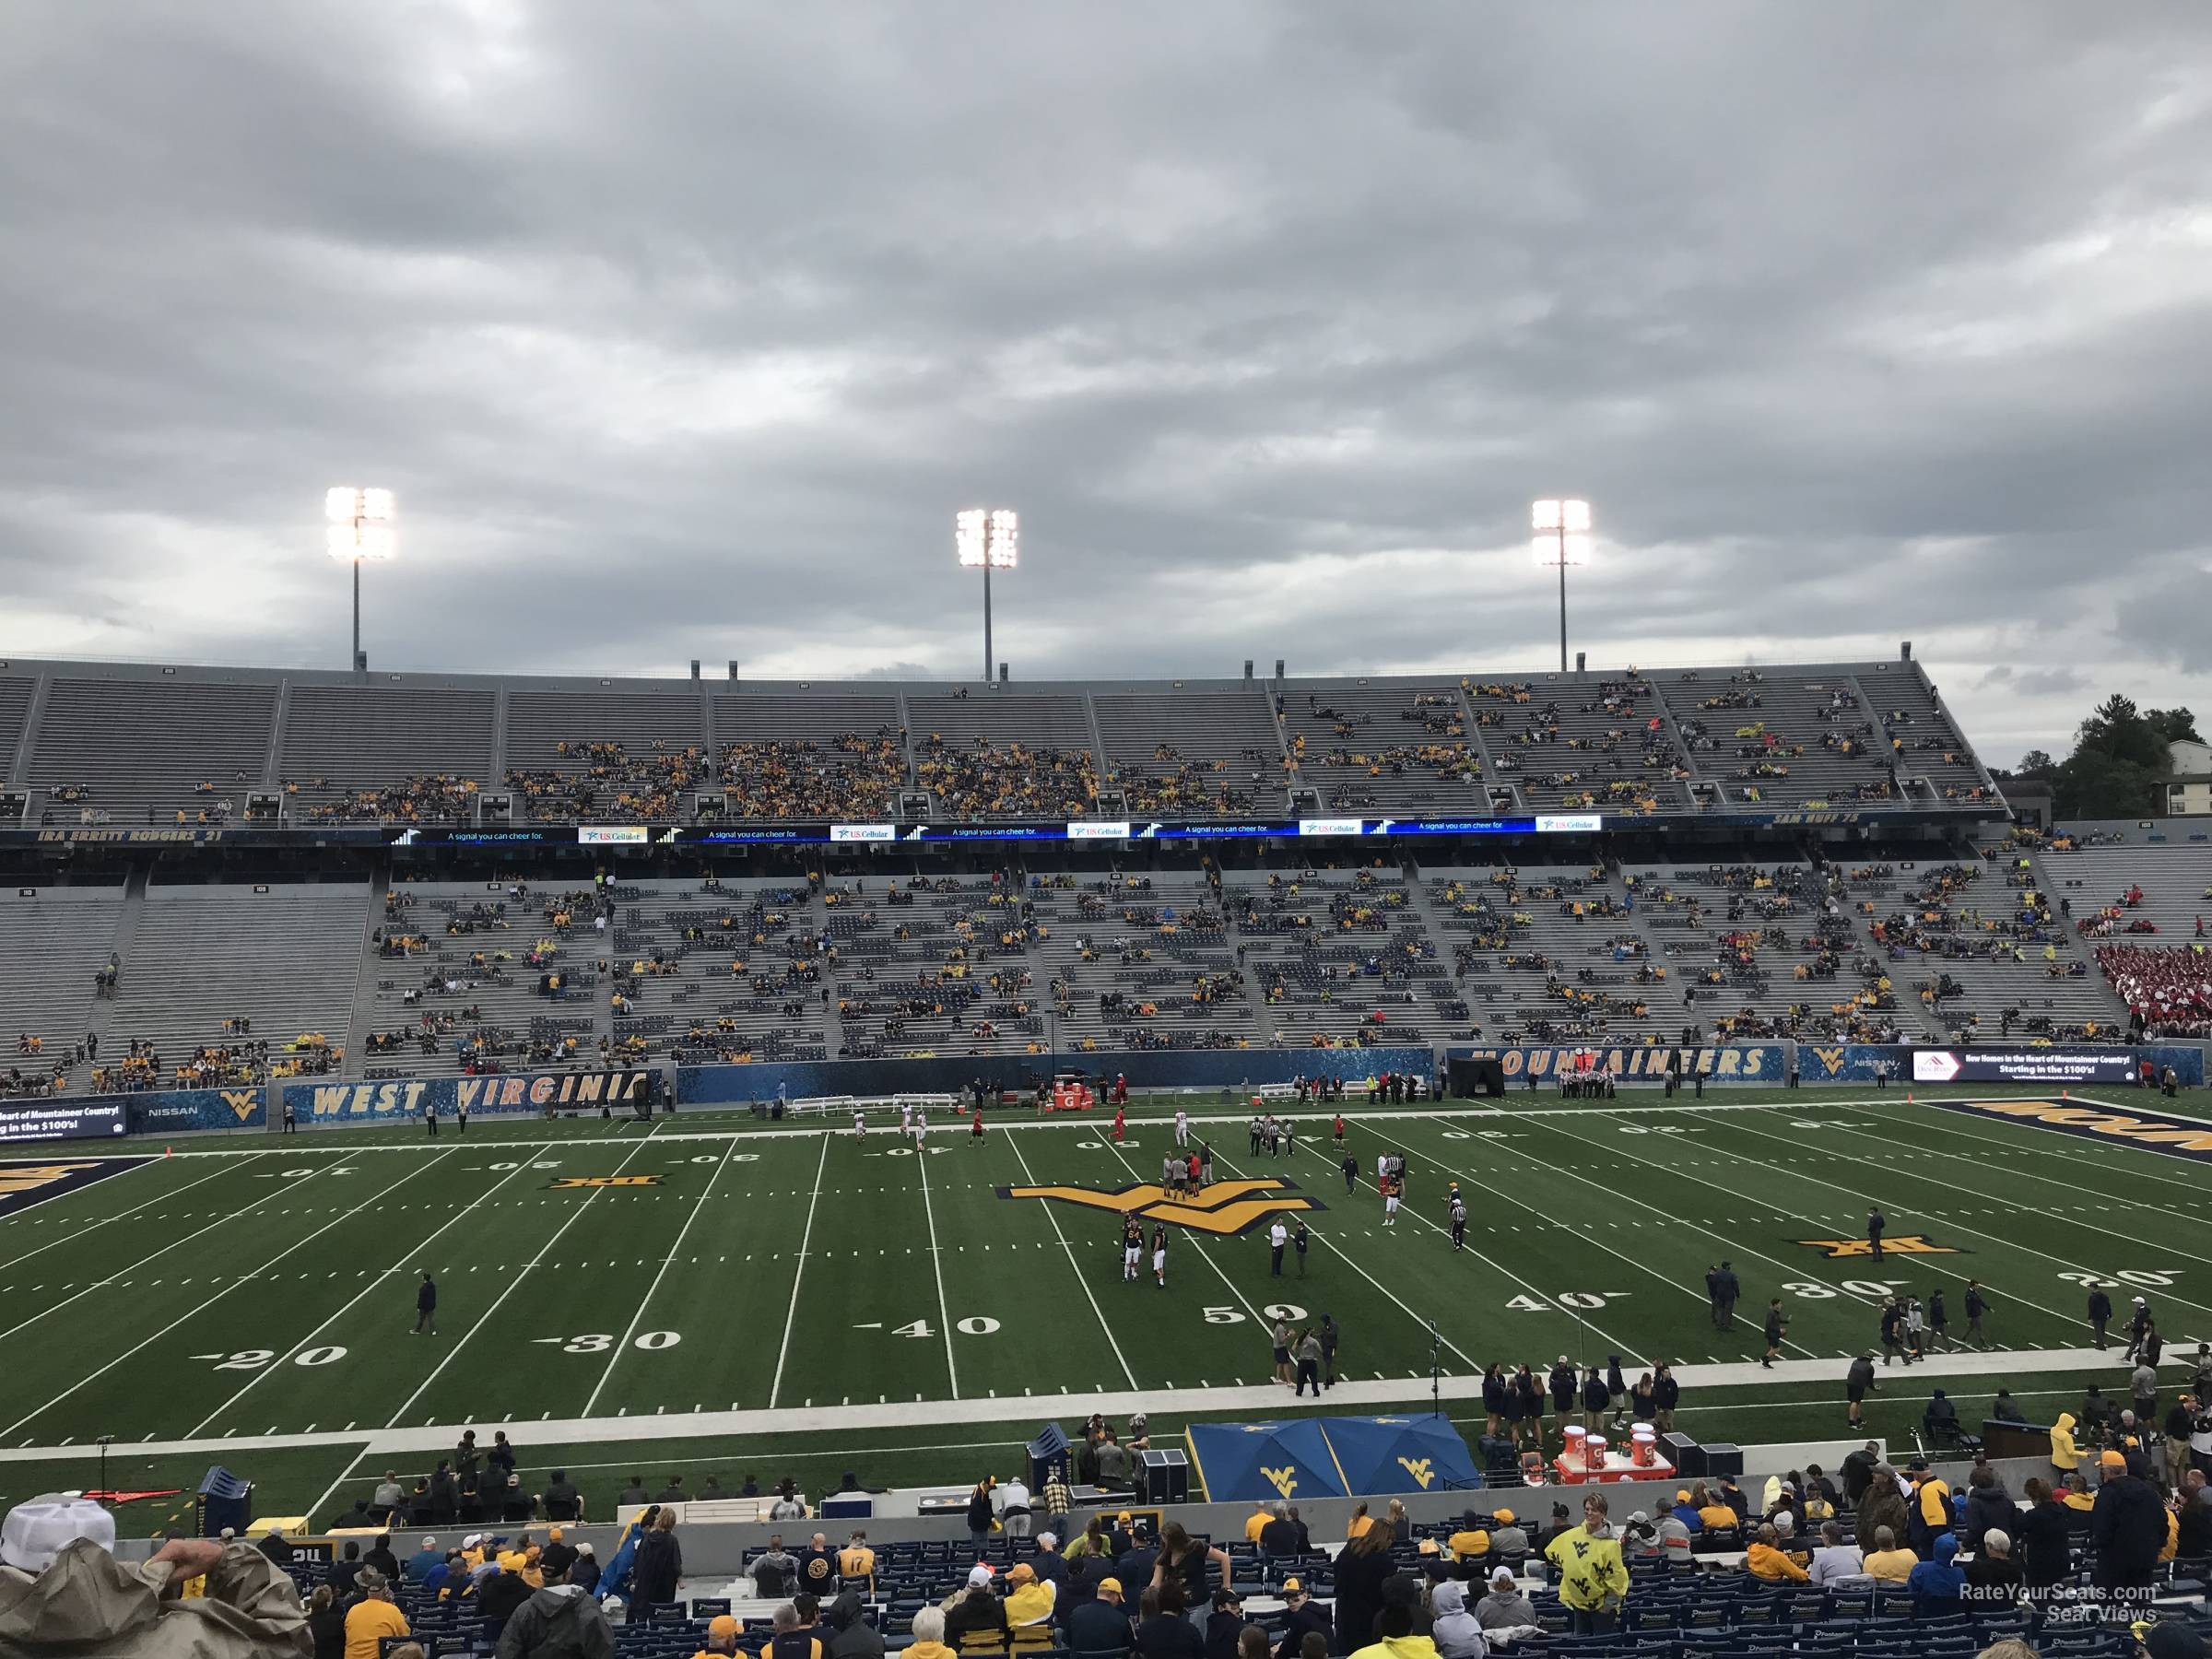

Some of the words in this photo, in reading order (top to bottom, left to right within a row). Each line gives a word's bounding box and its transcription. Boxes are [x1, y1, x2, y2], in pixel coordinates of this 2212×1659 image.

[1772, 815, 1801, 823] SAM
[1841, 813, 1859, 823] 75
[1192, 826, 1211, 834] signal
[1418, 821, 1425, 830] A
[1425, 821, 1444, 830] signal
[1444, 822, 1458, 830] you
[1473, 820, 1492, 829] cheer
[38, 831, 65, 841] IRA
[69, 831, 126, 841] ERRETT
[128, 831, 197, 841] RODGERS
[205, 831, 223, 841] 21
[455, 832, 477, 841] signal
[478, 833, 493, 841] you
[612, 832, 641, 841] Cellular
[715, 830, 736, 840] signal
[736, 831, 751, 840] you
[959, 828, 979, 837] signal
[979, 829, 993, 837] you
[1965, 1054, 1982, 1063] New
[1982, 1054, 2005, 1063] Homes
[2005, 1054, 2012, 1063] in
[2012, 1054, 2025, 1063] the
[2054, 1055, 2099, 1064] Mountaineer
[2100, 1056, 2130, 1065] Country!
[1999, 1065, 2037, 1075] Starting
[313, 1082, 427, 1115] WEST
[20, 1111, 30, 1120] of
[31, 1109, 83, 1119] Mountaineer
[84, 1106, 119, 1116] Country!
[148, 1106, 198, 1117] NISSAN
[8, 1124, 19, 1133] in
[21, 1123, 39, 1132] the
[1127, 1230, 1140, 1241] 64
[2056, 1268, 2174, 1288] 20
[1781, 1280, 1895, 1299] 30
[1504, 1292, 1606, 1312] 40
[1201, 1303, 1309, 1324] 50
[891, 1316, 1001, 1338] 40
[561, 1330, 682, 1354] 30
[212, 1345, 348, 1371] 20
[850, 1557, 865, 1572] 17
